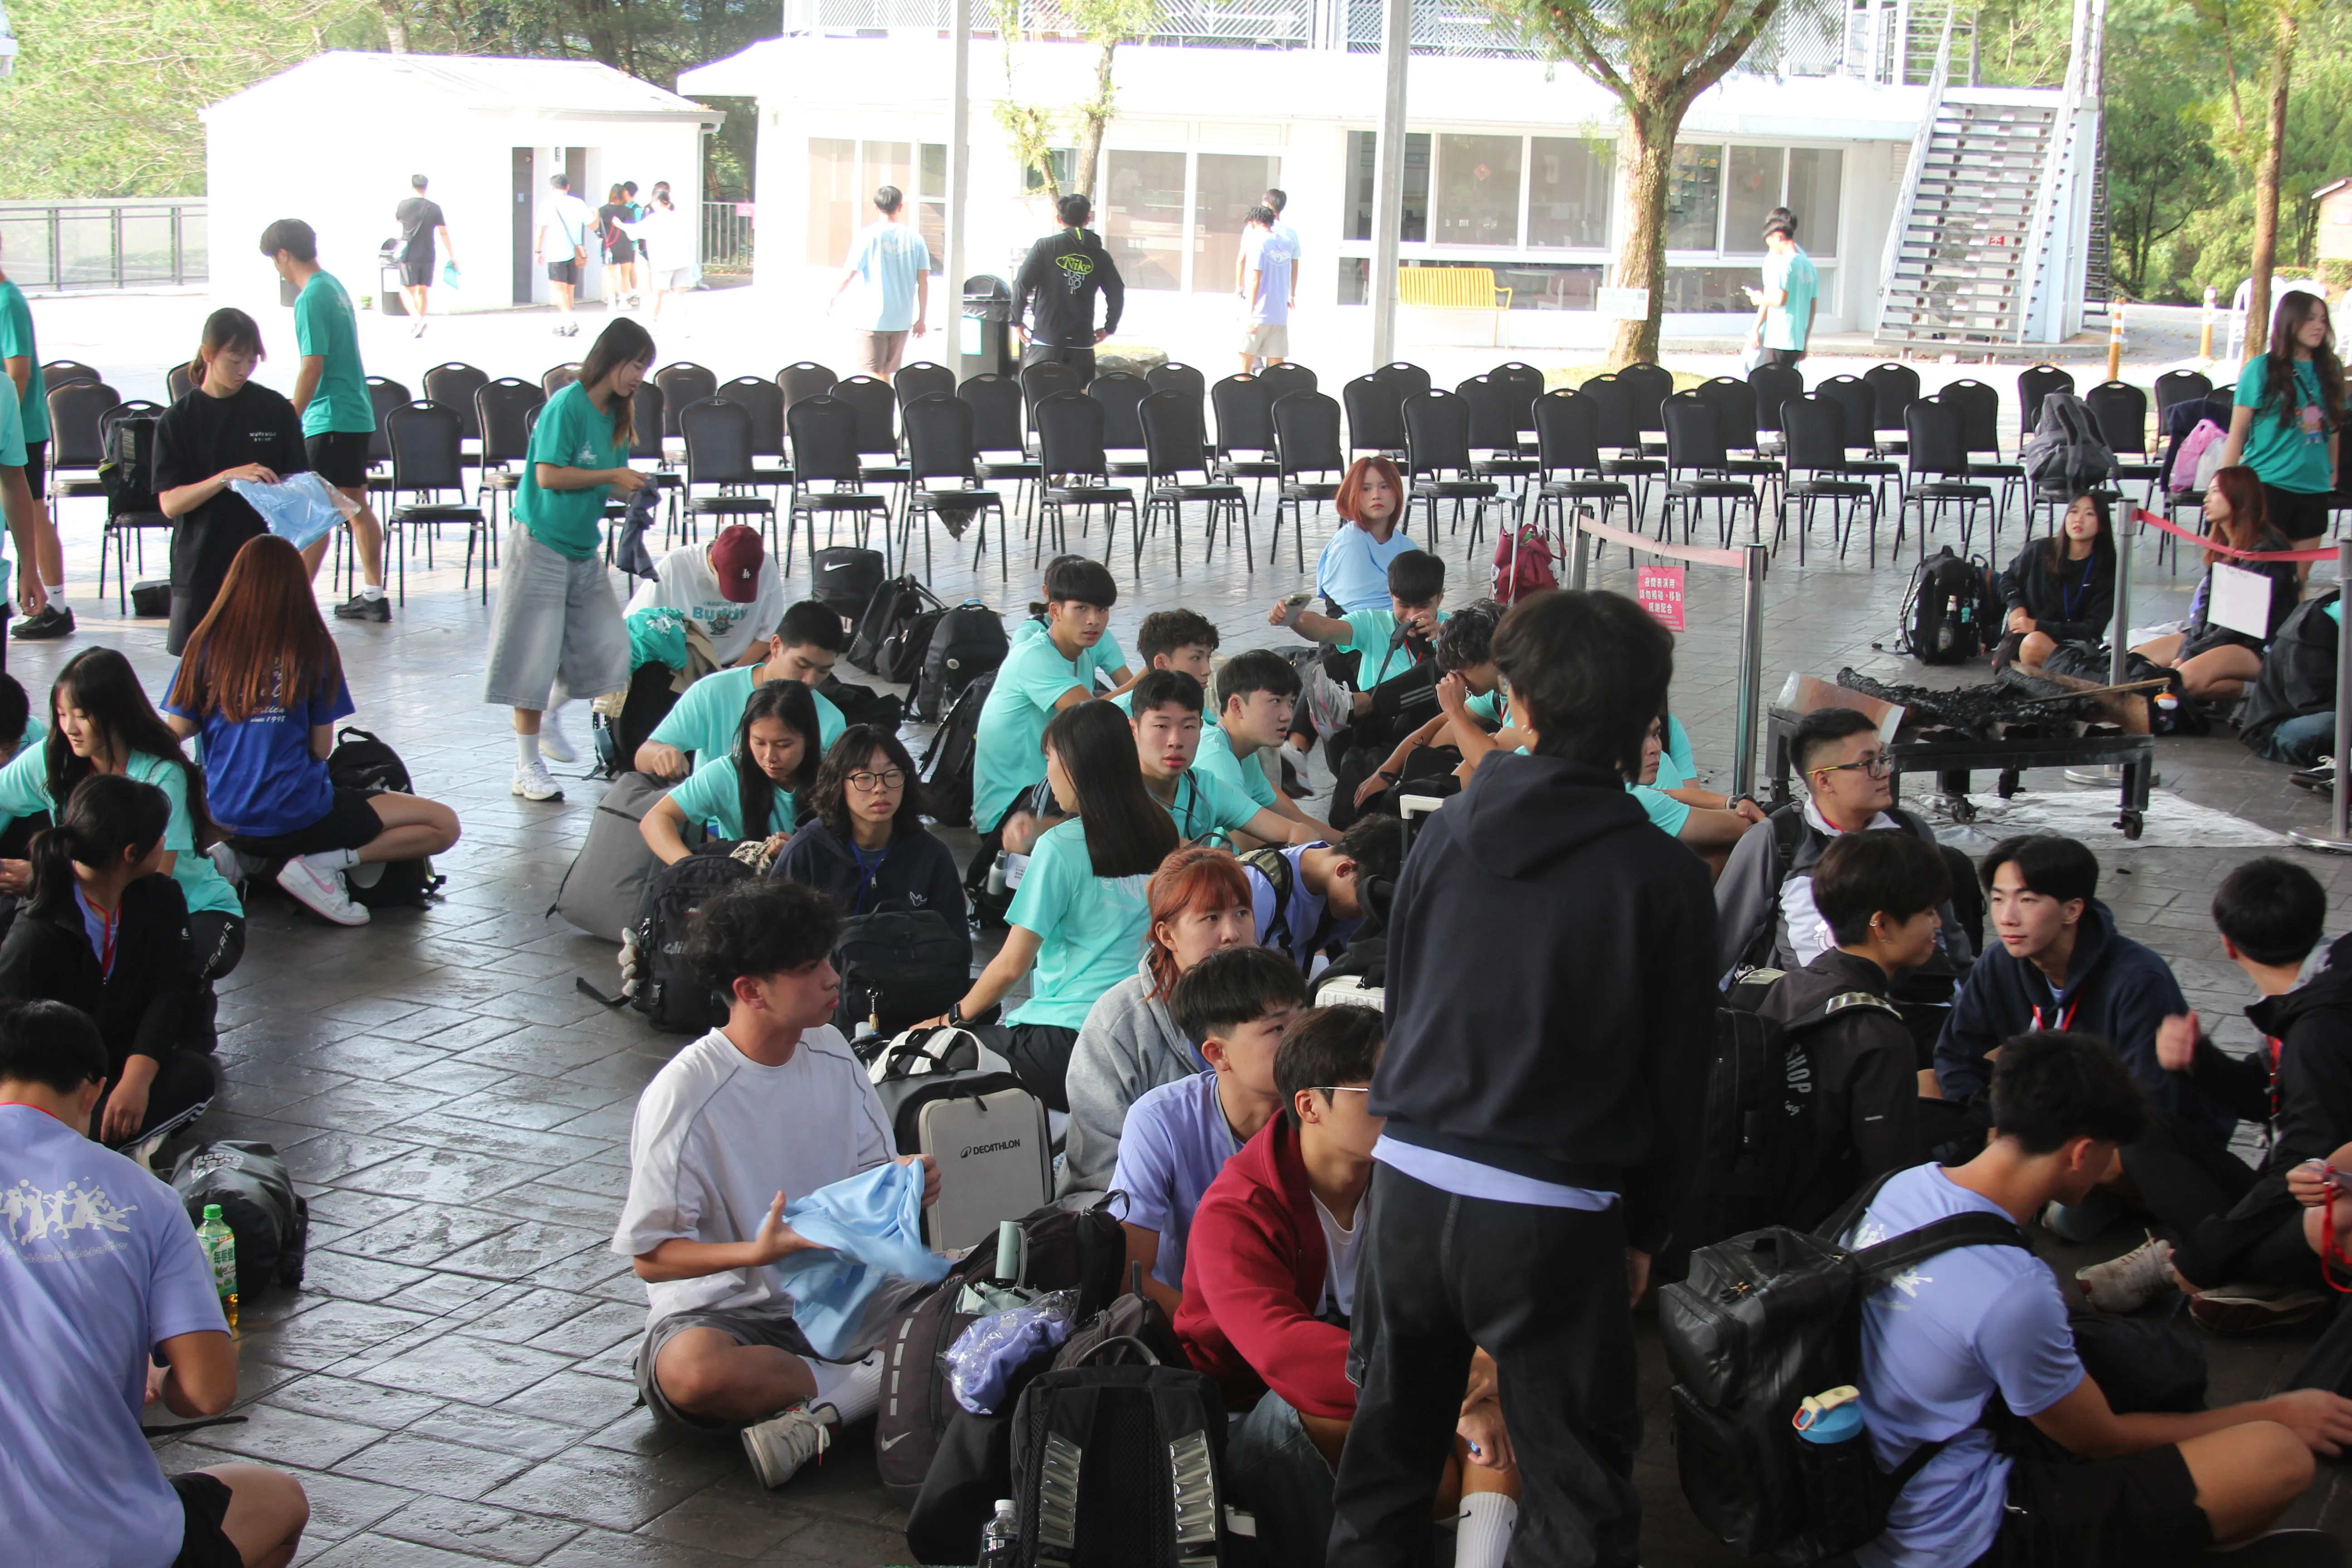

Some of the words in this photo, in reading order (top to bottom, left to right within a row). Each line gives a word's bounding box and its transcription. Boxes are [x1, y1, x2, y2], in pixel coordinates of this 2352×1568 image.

[1063, 256, 1091, 273] Nike
[1063, 270, 1085, 281] JUST
[1068, 278, 1081, 288] DO
[743, 569, 751, 578] LA
[1645, 577, 1675, 589] 夜間表演用
[692, 606, 748, 621] Buddy
[1648, 603, 1672, 614] 感謝配合
[1785, 1043, 1812, 1093] SHOP
[973, 1138, 1021, 1155] DECATHLON
